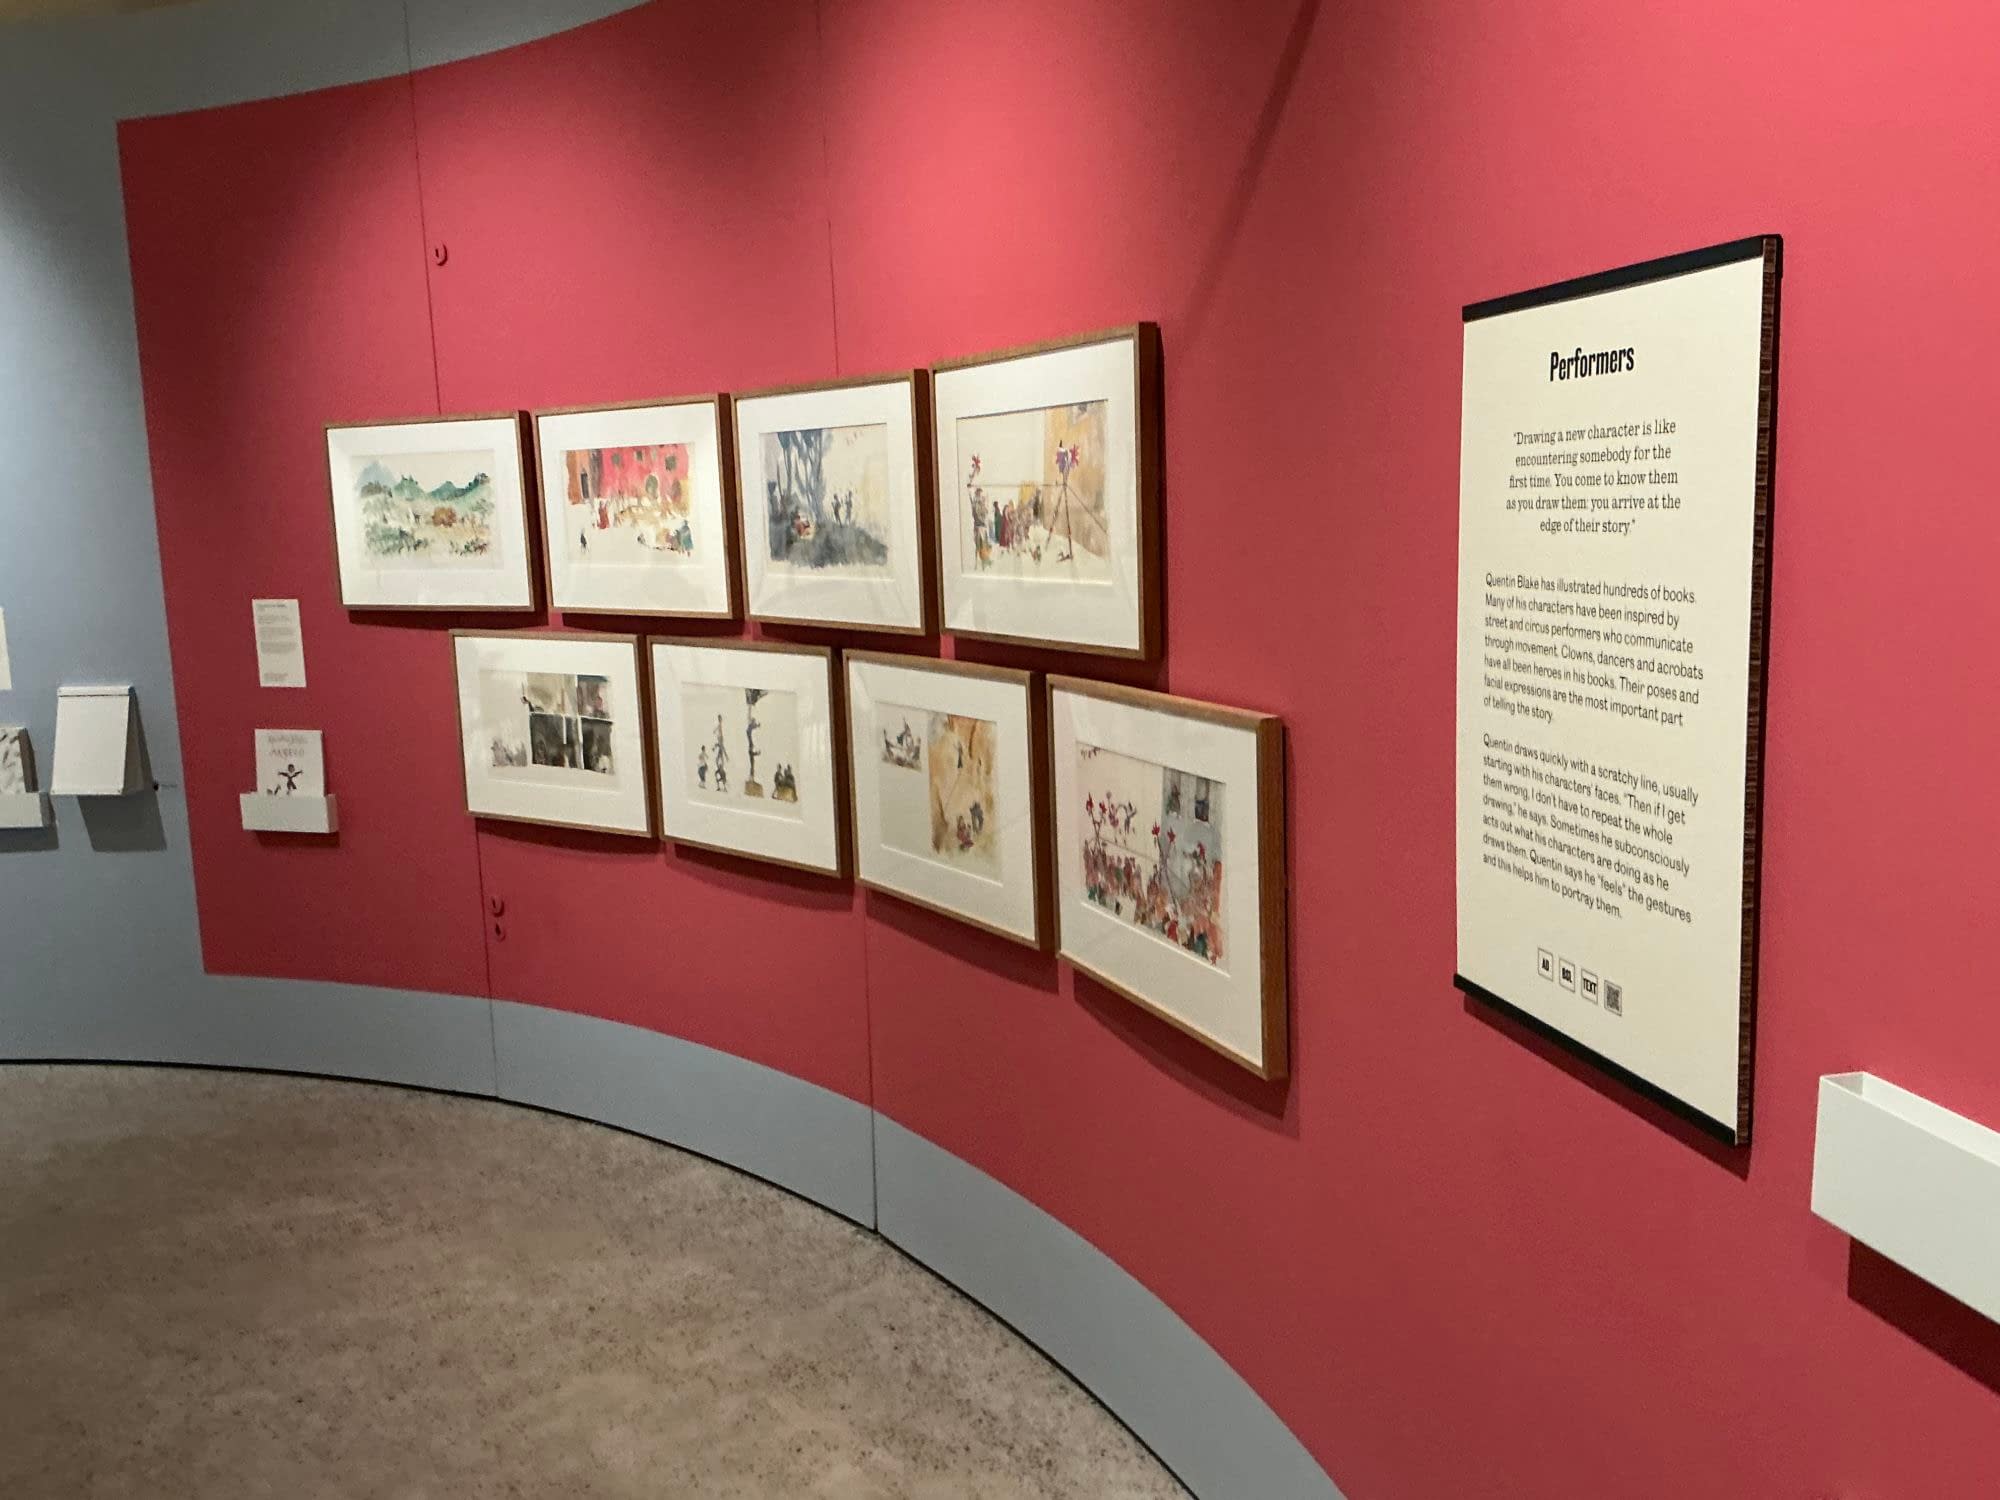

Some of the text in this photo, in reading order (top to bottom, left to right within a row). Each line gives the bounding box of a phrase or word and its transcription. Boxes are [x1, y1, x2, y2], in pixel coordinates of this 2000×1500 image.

[1549, 346, 1635, 383] Performers
[1557, 431, 1564, 442] a
[1565, 429, 1586, 442] new
[1587, 423, 1641, 440] character
[1642, 421, 1653, 436] is
[1654, 419, 1676, 435] like
[1515, 444, 1671, 467] encountering somebody for the
[1509, 474, 1528, 489] first
[1554, 473, 1573, 487] You
[1574, 474, 1602, 487] come
[1603, 472, 1615, 487] to
[1616, 470, 1646, 486] know
[1648, 469, 1678, 485] them
[1506, 499, 1517, 510] as
[1517, 499, 1534, 512] you
[1535, 495, 1560, 510] draw
[1591, 498, 1610, 513] you
[1611, 494, 1645, 510] arrive
[1647, 494, 1660, 510] at
[1661, 494, 1681, 510] the
[1539, 517, 1562, 535] edge
[1563, 518, 1575, 533] of
[1574, 517, 1601, 533] their
[1485, 572, 1697, 604] Quentin Blake has illustrated hundreds of books.
[1485, 592, 1680, 631] Many of his characters have been inspired by
[1484, 616, 1693, 654] street and circus performers who communicate
[1484, 634, 1514, 653] through
[1561, 644, 1596, 665] Clowns,
[1597, 650, 1635, 670] dancers
[1636, 657, 1655, 673] and
[1656, 661, 1704, 680] acrobats
[1483, 653, 1699, 705] have all been heroes in his books. Their poses and
[1483, 695, 1491, 706] of
[1492, 696, 1516, 716] telling
[1517, 701, 1530, 716] the
[1484, 673, 1684, 727] facial expressions are the most important part
[1483, 733, 1699, 807] Quentin draws quickly with a scratchy line, usually
[1482, 773, 1503, 790] them
[1531, 787, 1535, 800] I
[1535, 790, 1557, 808] don't
[1558, 795, 1579, 815] have
[1580, 802, 1590, 818] to
[1591, 809, 1623, 829] repeat
[1624, 817, 1641, 835] the
[1642, 824, 1673, 845] whole
[1483, 755, 1513, 777] starting
[1513, 764, 1531, 778] with
[1531, 767, 1544, 783] his
[1594, 784, 1622, 806] faces.
[1653, 802, 1662, 817] if
[1662, 803, 1666, 819] I
[1667, 809, 1686, 828] get
[1482, 814, 1669, 891] acts out what his characters are doing as he
[1517, 803, 1528, 819] he
[1550, 814, 1600, 844] Sometimes
[1601, 831, 1613, 848] he
[1614, 839, 1690, 878] subconsciously
[1482, 832, 1506, 851] draws
[1529, 848, 1563, 873] Quentin
[1564, 864, 1583, 882] says
[1584, 868, 1596, 886] he
[1627, 886, 1644, 905] the
[1645, 896, 1692, 923] gestures
[1482, 853, 1497, 867] and
[1497, 857, 1512, 873] this
[1512, 863, 1534, 882] helps
[1534, 871, 1550, 888] him
[1551, 878, 1560, 893] to
[1561, 885, 1594, 910] portray
[1583, 977, 1597, 995] TEXT
